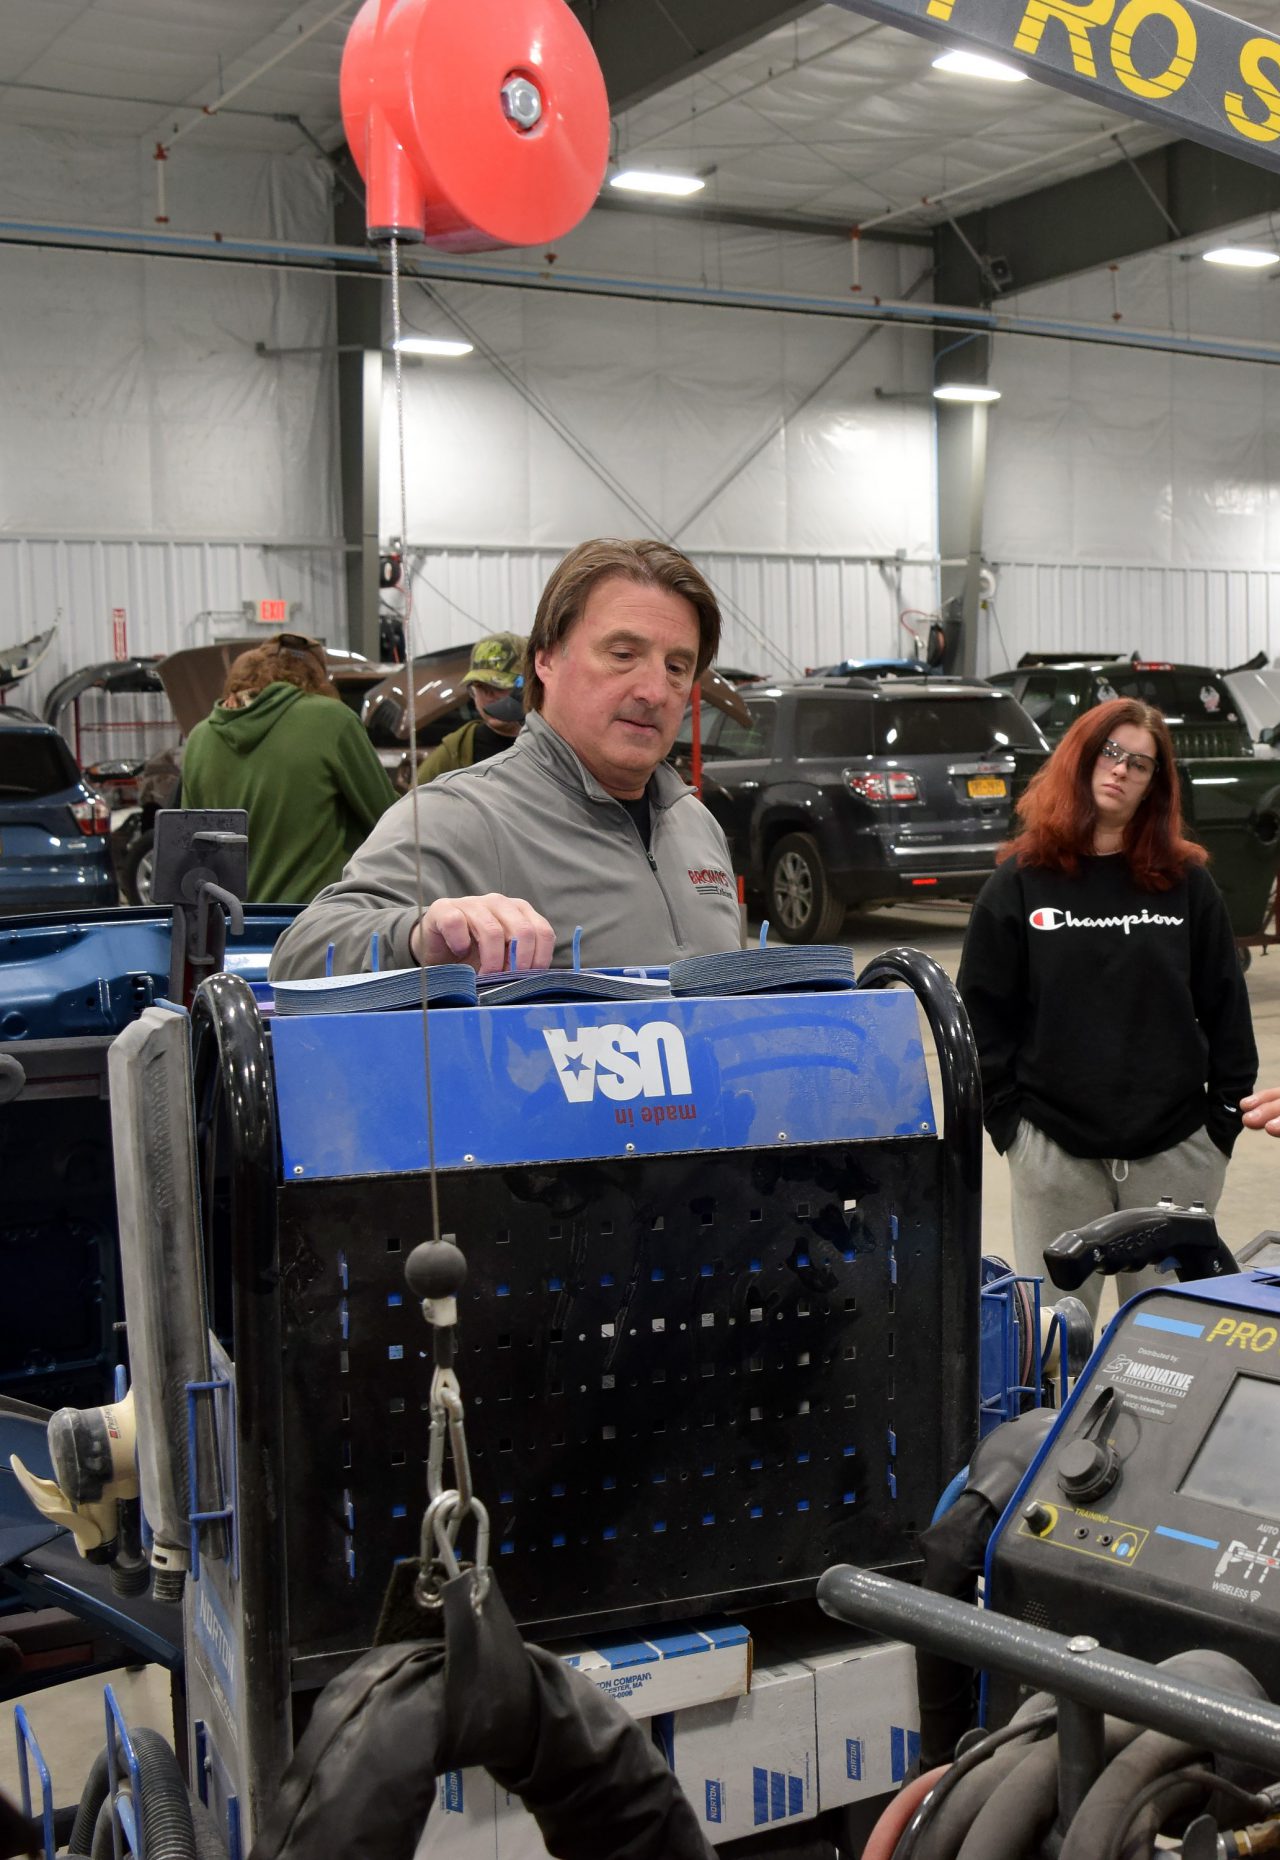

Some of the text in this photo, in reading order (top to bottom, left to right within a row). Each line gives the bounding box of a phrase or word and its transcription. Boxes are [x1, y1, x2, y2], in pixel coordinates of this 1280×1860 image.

[918, 0, 1198, 99] RO
[261, 599, 288, 620] EXIT
[1029, 906, 1185, 936] Champion
[542, 1020, 693, 1104] USA
[615, 1103, 697, 1128] made in
[1206, 1317, 1278, 1352] PRO
[1138, 1347, 1180, 1364] Distributed by
[1124, 1360, 1195, 1389] INNOVATIVE
[1150, 1381, 1188, 1398] Technology
[1075, 1507, 1109, 1524] TRAINING
[1256, 1523, 1280, 1536] AUTO
[1211, 1580, 1249, 1600] WIRELESS
[200, 1589, 235, 1682] NORTON
[450, 1772, 458, 1808] NORTON
